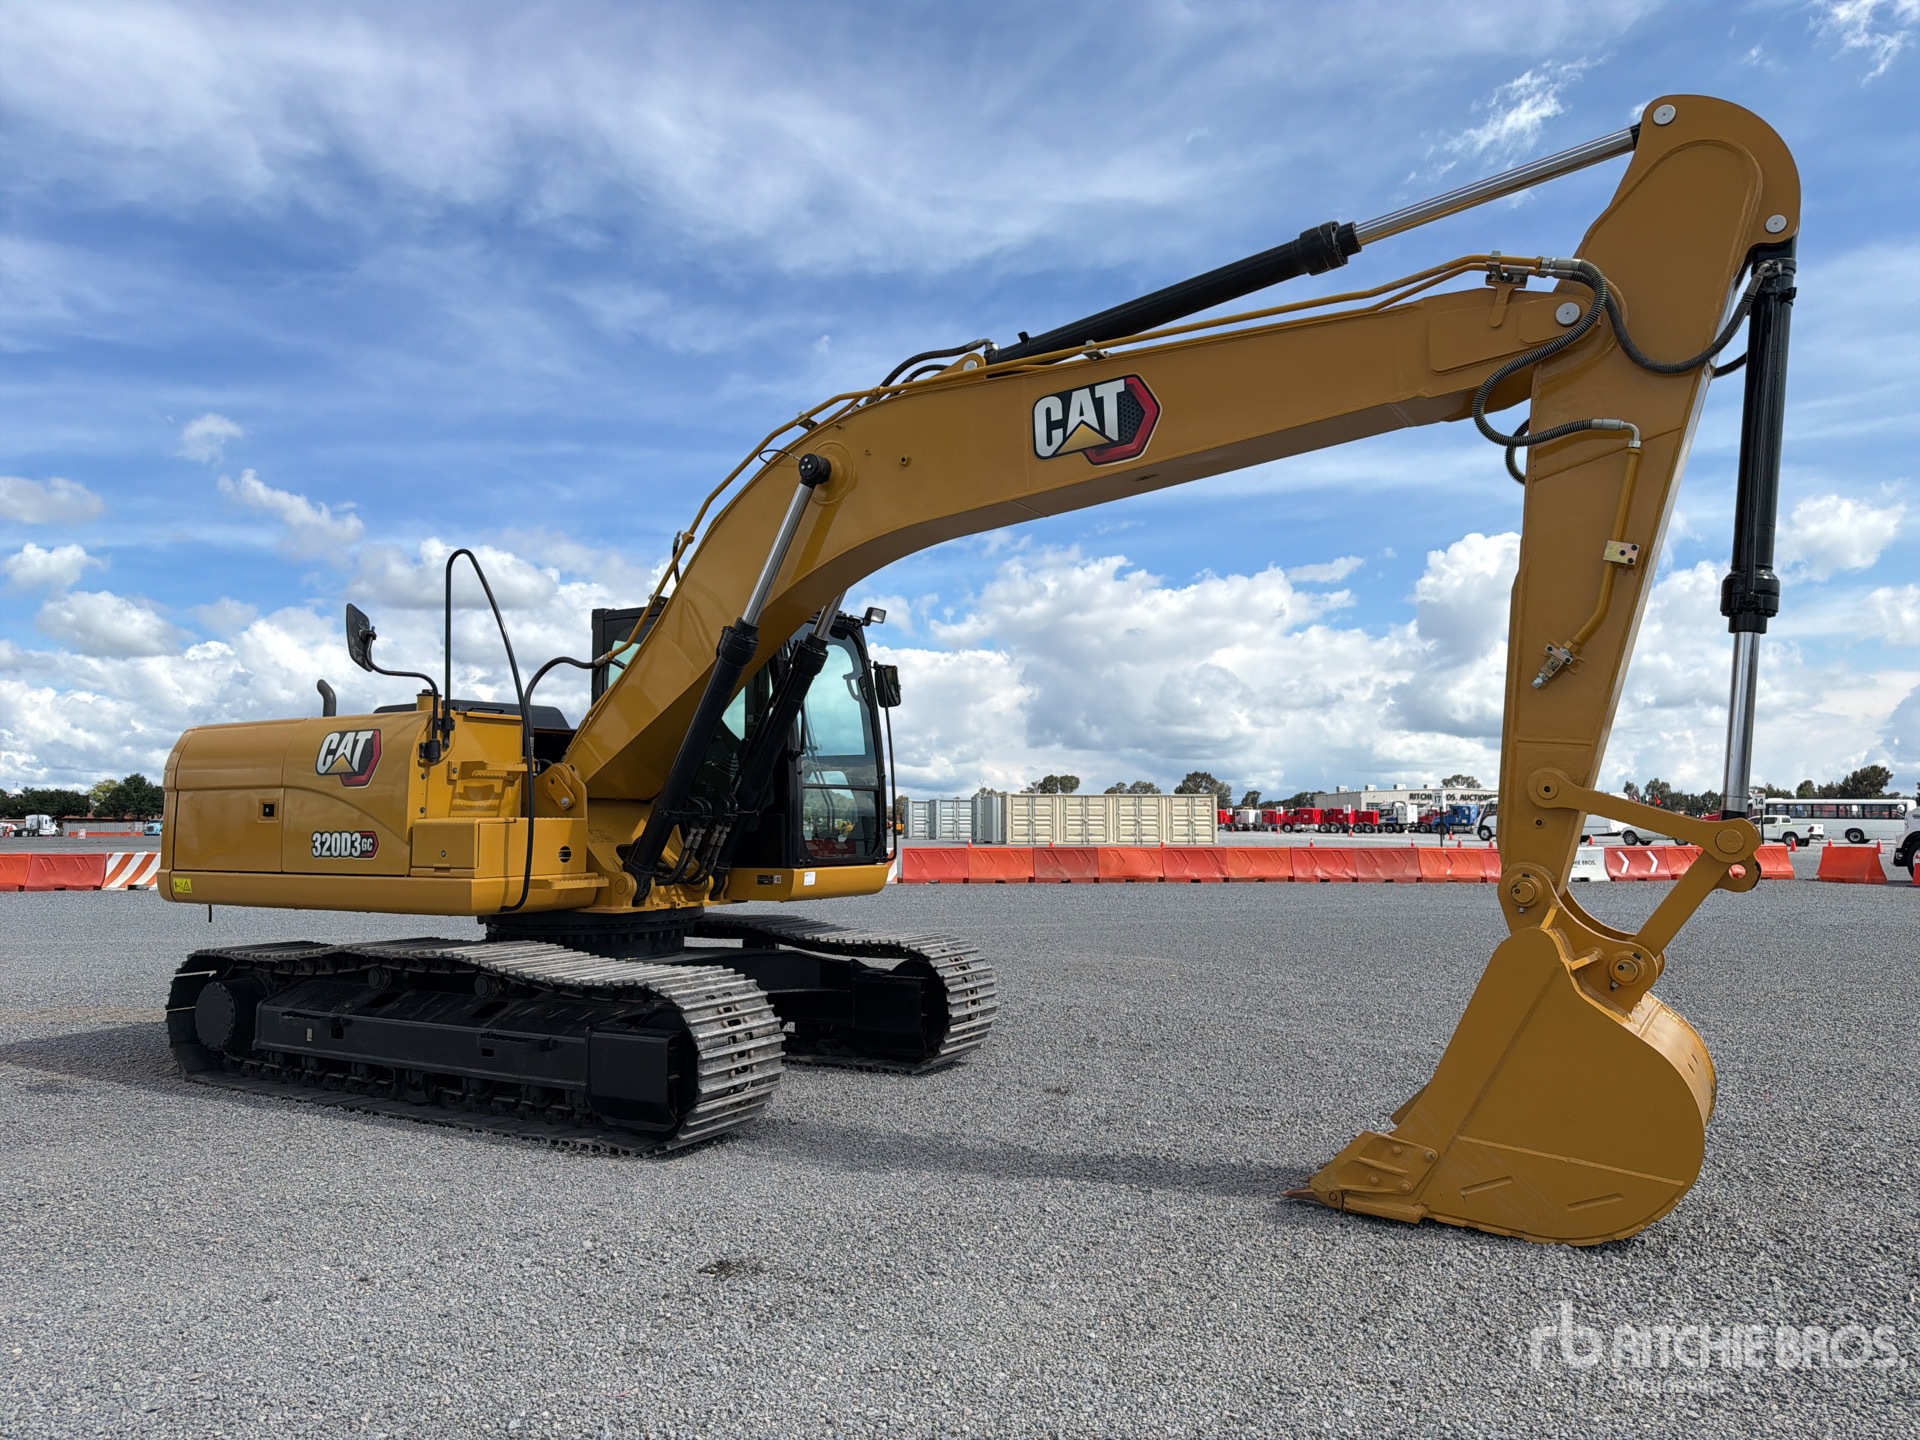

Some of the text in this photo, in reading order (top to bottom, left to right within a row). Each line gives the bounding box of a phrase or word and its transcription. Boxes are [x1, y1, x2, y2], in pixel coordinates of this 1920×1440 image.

[1034, 379, 1125, 457] CAT
[316, 731, 374, 774] CAT
[1409, 793, 1432, 801] RITCHI
[1434, 795, 1441, 803] 17
[1754, 797, 1764, 806] 14
[312, 832, 373, 857] 320D3 GC
